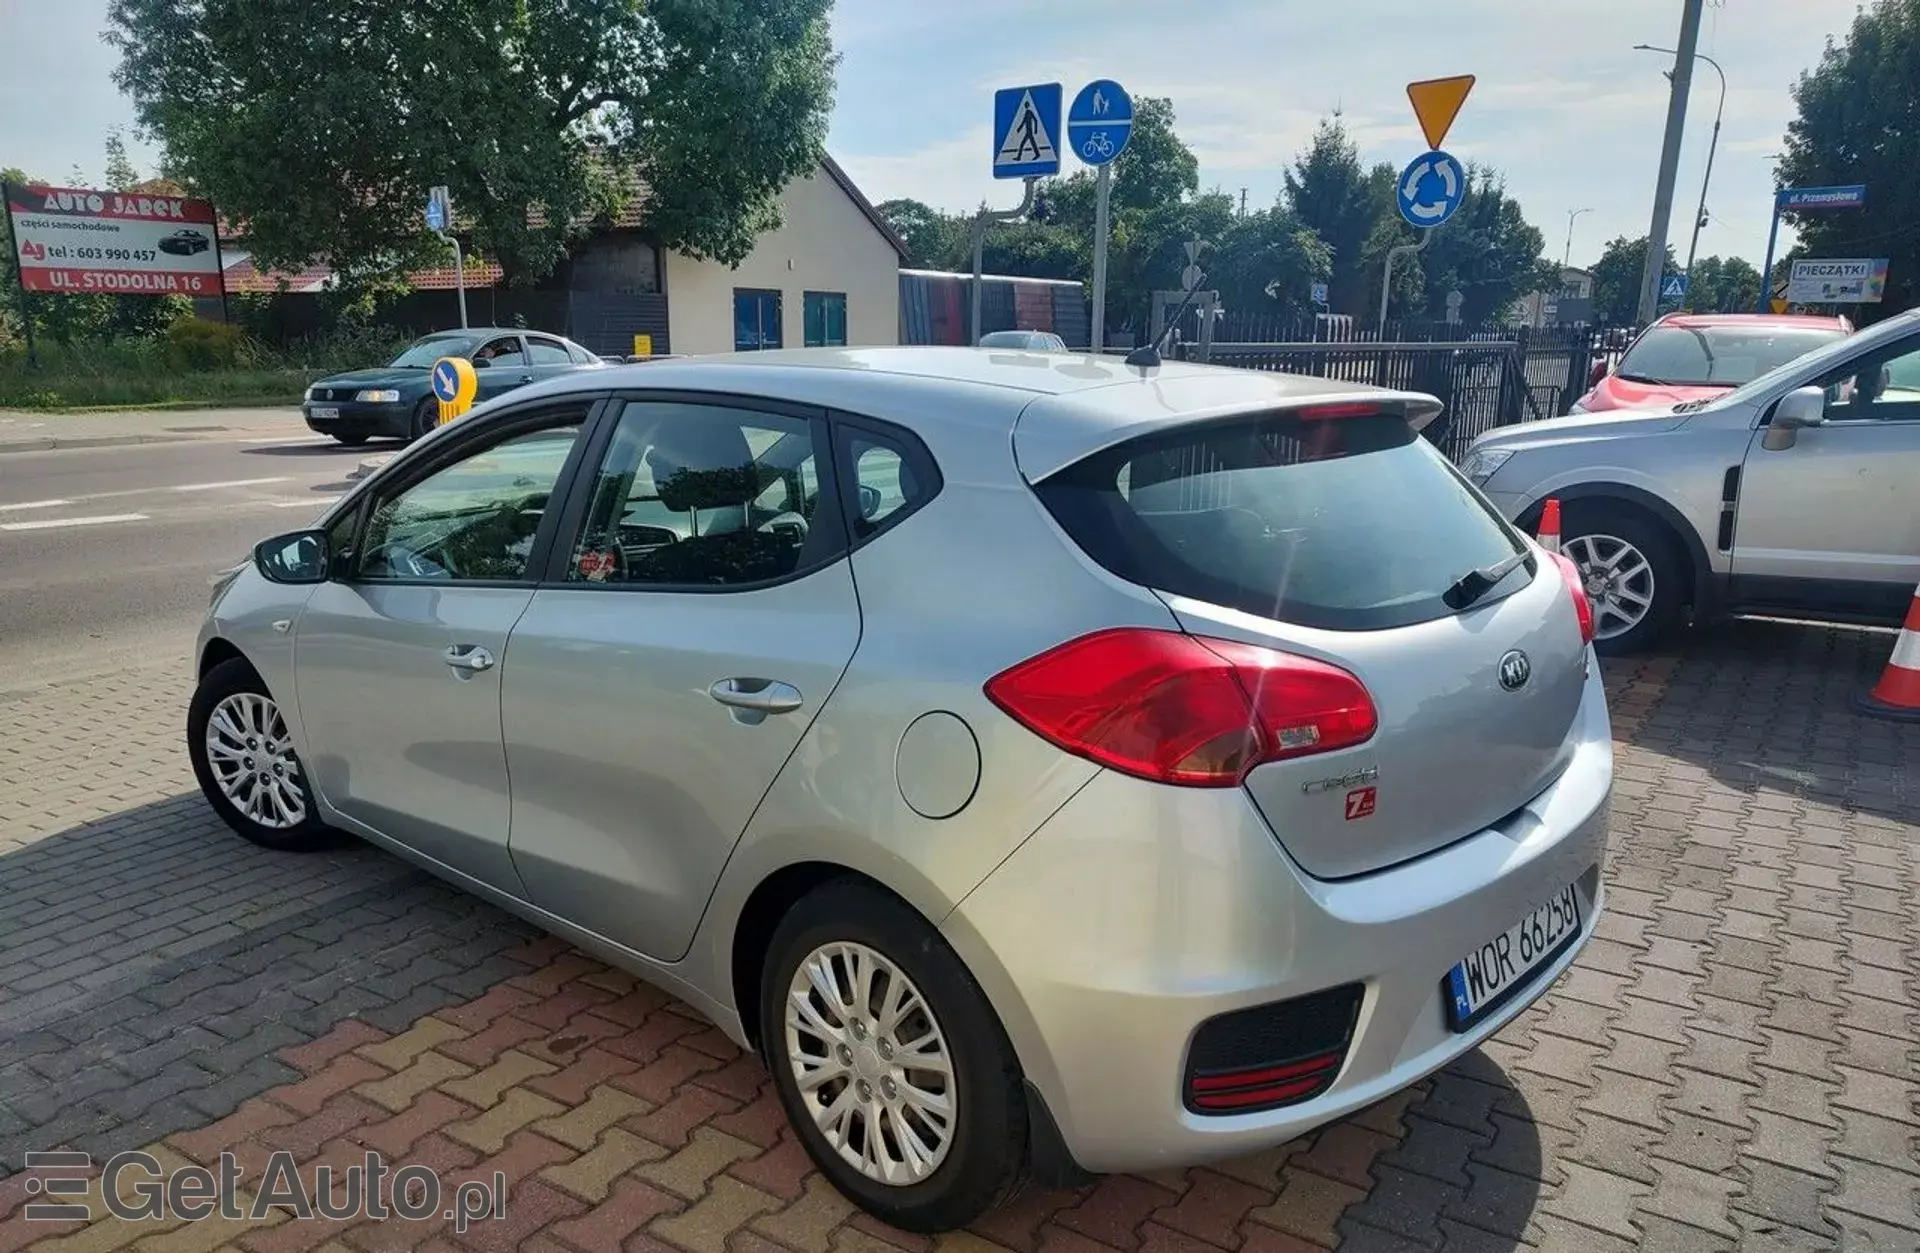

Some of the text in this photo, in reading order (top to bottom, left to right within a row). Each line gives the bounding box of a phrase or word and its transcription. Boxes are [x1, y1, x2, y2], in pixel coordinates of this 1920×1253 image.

[44, 192, 104, 212] AUTO
[21, 220, 120, 232] części samochodowe
[77, 247, 101, 260] 603
[105, 249, 130, 261] 990
[134, 250, 156, 262] 457
[50, 271, 201, 290] UL. STODOLNA 16
[1464, 932, 1515, 1004] WOR
[1519, 887, 1574, 963] 66258
